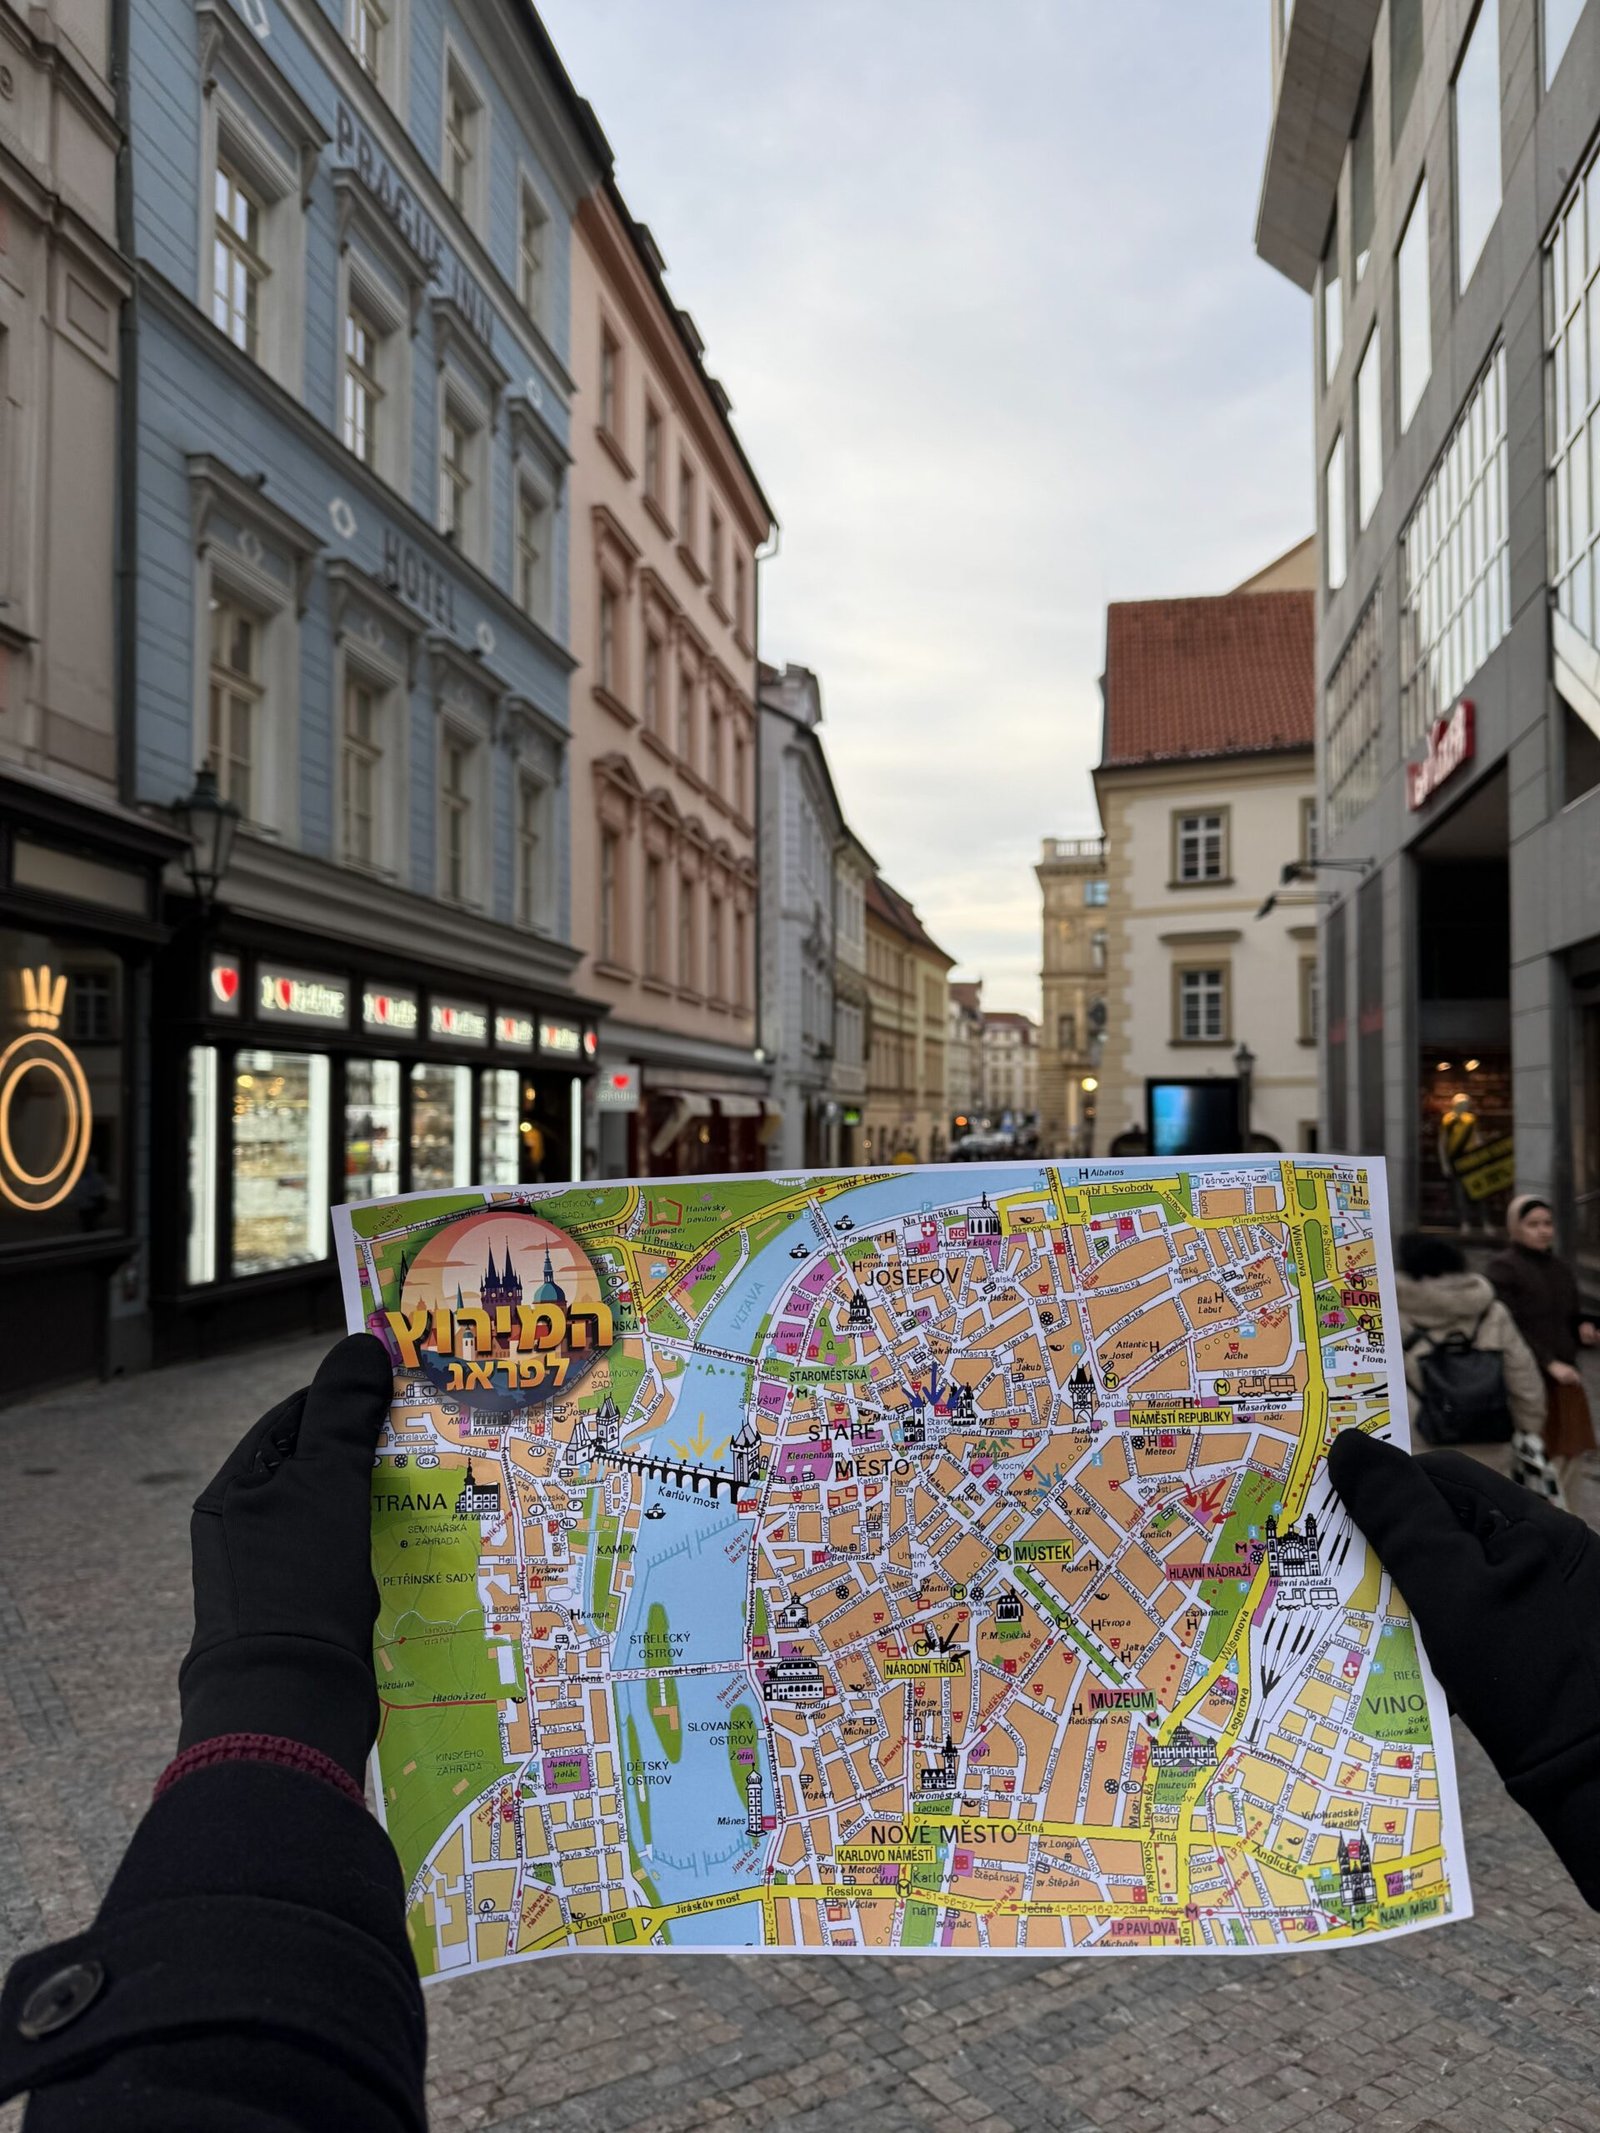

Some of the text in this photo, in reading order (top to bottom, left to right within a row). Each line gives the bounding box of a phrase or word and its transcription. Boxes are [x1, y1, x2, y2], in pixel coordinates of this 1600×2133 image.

[1113, 1184, 1153, 1193] Svobody
[1291, 1225, 1306, 1277] Wilsonova
[865, 1268, 960, 1287] JOSEFOV
[730, 1282, 765, 1331] VLTAVA
[385, 1302, 614, 1370] המירוץ
[447, 1353, 570, 1391] לפראג
[591, 1369, 639, 1378] VOJANOVY
[591, 1380, 614, 1389] SADY
[1238, 1403, 1286, 1412] Masarykovo
[1132, 1411, 1231, 1425] NÁMĚSTÍ REPUBLIKY
[809, 1422, 876, 1441] STARÉ
[419, 1457, 437, 1465] USA
[836, 1456, 910, 1477] MĚSTO
[374, 1494, 447, 1511] TRANA
[657, 1486, 720, 1509] Karlův most
[597, 1545, 637, 1554] KAMPA
[1169, 1562, 1251, 1578] HLAVNÍ NÁDRAŽÍ
[446, 1574, 476, 1584] SADY
[1102, 1619, 1131, 1627] Evropa
[630, 1632, 691, 1644] STŘELECKÝ
[638, 1649, 683, 1659] OSTROV
[886, 1662, 930, 1675] NÁRODNÍ
[1091, 1693, 1154, 1709] MUZEUM
[1227, 1688, 1249, 1737] Legerova
[710, 1735, 754, 1746] OSTROV
[628, 1775, 671, 1785] OSTROV
[1158, 1780, 1196, 1789] muzeum
[872, 1820, 1017, 1844] NOVÉ MĚSTO
[838, 1846, 933, 1862] KARLOVO NÁMĚSTÍ
[913, 1873, 959, 1883] Karlovo
[827, 1887, 872, 1896] Resslova
[717, 1894, 740, 1905] most
